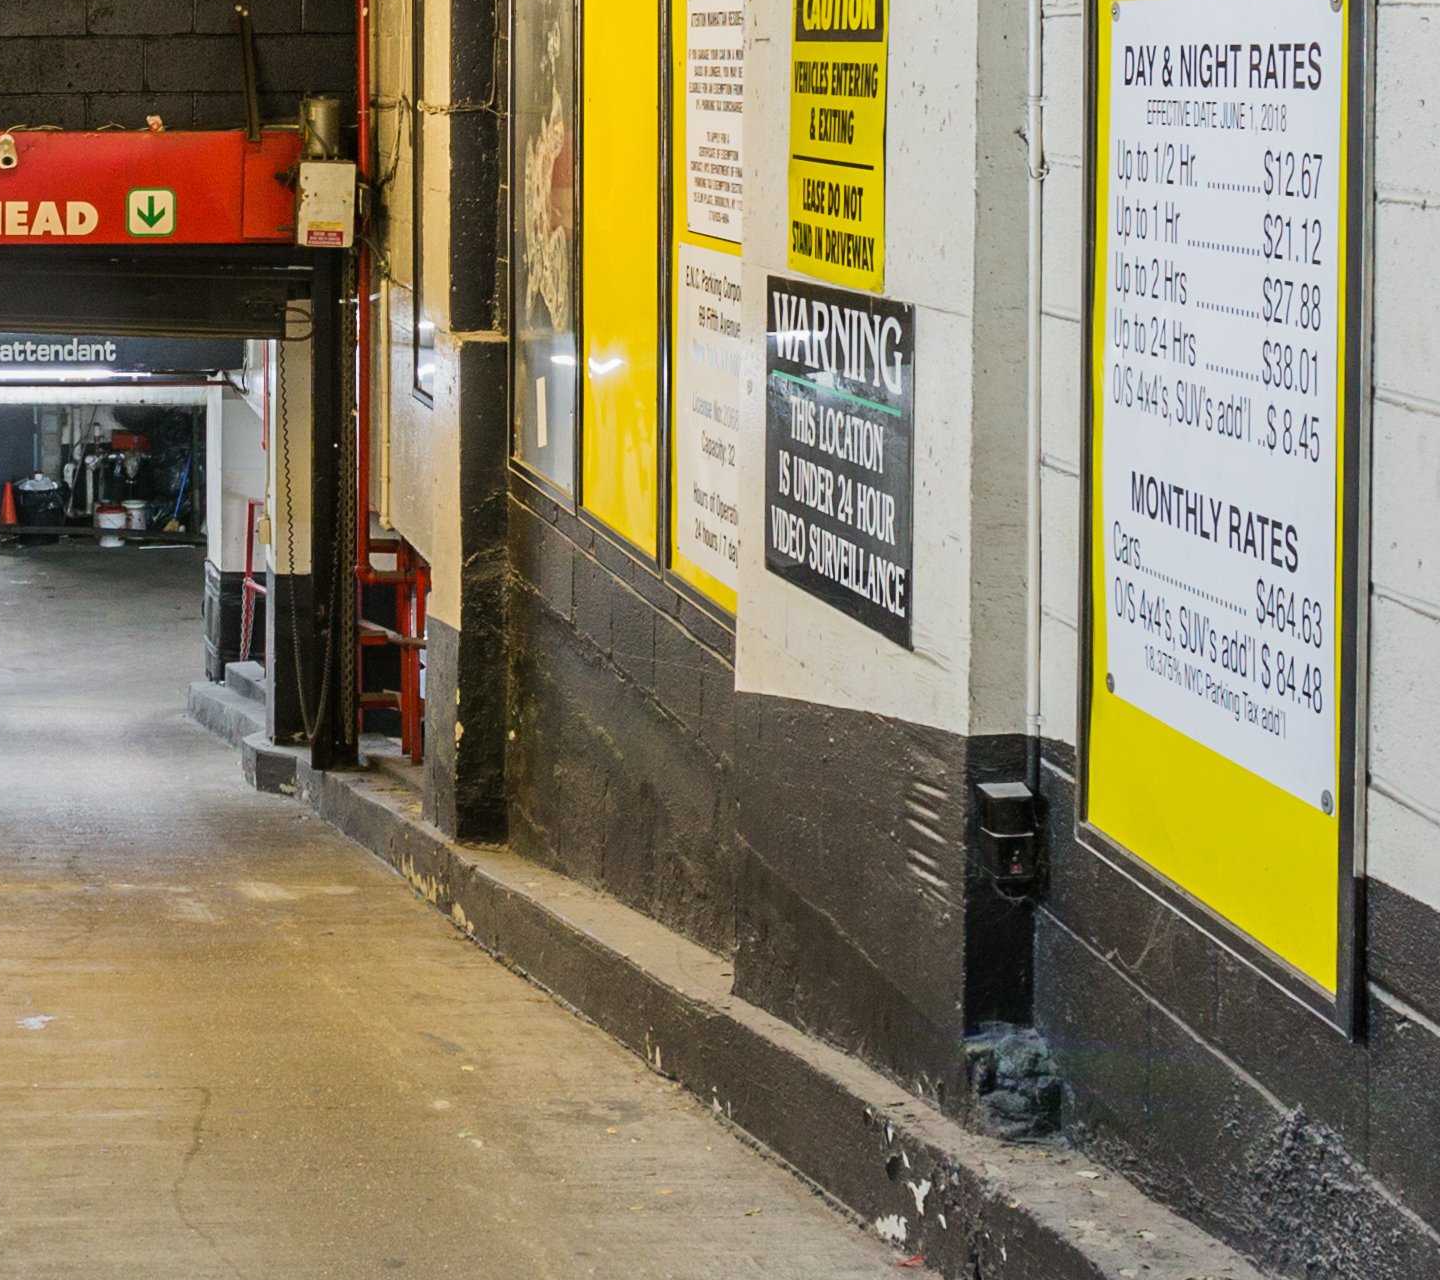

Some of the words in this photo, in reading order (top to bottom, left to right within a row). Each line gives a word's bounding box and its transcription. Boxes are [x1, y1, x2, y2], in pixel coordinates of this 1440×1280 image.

[794, 61, 829, 95] VEHICLES
[831, 62, 878, 98] ENTERING
[1124, 45, 1156, 86] DAY
[1162, 45, 1173, 87] &
[1180, 43, 1242, 88] NIGHT
[1249, 41, 1322, 90] RATES
[810, 107, 816, 141] &
[818, 108, 854, 145] EXITING
[1147, 99, 1191, 127] EFFECTIVE
[1193, 100, 1217, 128] DATE
[1220, 102, 1245, 129] JUNE
[1261, 103, 1287, 132] 2018
[828, 182, 840, 217] DO
[844, 184, 863, 222] NOT
[1117, 139, 1132, 190] Up
[1136, 141, 1148, 182] to
[1153, 141, 1174, 185] 1/2
[1180, 143, 1198, 187] Hr.
[1263, 149, 1323, 199] $12.67
[792, 220, 812, 256] STAND
[815, 226, 822, 260] IN
[825, 228, 875, 272] DRIVEWAY
[1116, 195, 1132, 246] Up
[1135, 200, 1147, 240] to
[1152, 200, 1158, 242] 1
[1165, 201, 1180, 244] Hr
[1262, 211, 1322, 265] $21.12
[1115, 251, 1130, 302] Up
[1135, 255, 1146, 297] to
[1151, 258, 1159, 299] 2
[1164, 260, 1187, 305] Hrs
[1262, 273, 1321, 332] $27.88
[0, 338, 117, 362] attendant
[772, 291, 903, 395] WARNING
[1114, 307, 1130, 359] Up
[1134, 313, 1146, 354] to
[1151, 316, 1167, 359] 24
[1172, 320, 1196, 367] Hrs
[1262, 337, 1318, 397] $38.01
[1113, 363, 1133, 408] O/S
[1176, 379, 1213, 431] SUV's
[791, 395, 816, 448] THIS
[820, 406, 883, 474] LOCATION
[778, 450, 791, 496] IS
[793, 455, 834, 518] UNDER
[837, 475, 853, 526] 24
[857, 482, 896, 546] HOUR
[1131, 470, 1222, 543] MONTHLY
[1229, 505, 1298, 573] RATES
[771, 504, 806, 564] VIDEO
[809, 522, 906, 618] SURVEILLANCE
[1113, 520, 1141, 570] Cars
[1256, 576, 1322, 649] $464.63
[1114, 576, 1136, 624] O/S
[1179, 606, 1217, 664] SUV's
[1276, 650, 1322, 714] 84.48
[1144, 644, 1182, 686] 18.375%
[1184, 663, 1203, 696] NYC
[1206, 672, 1240, 722] Parking
[1242, 691, 1259, 725] Tax
